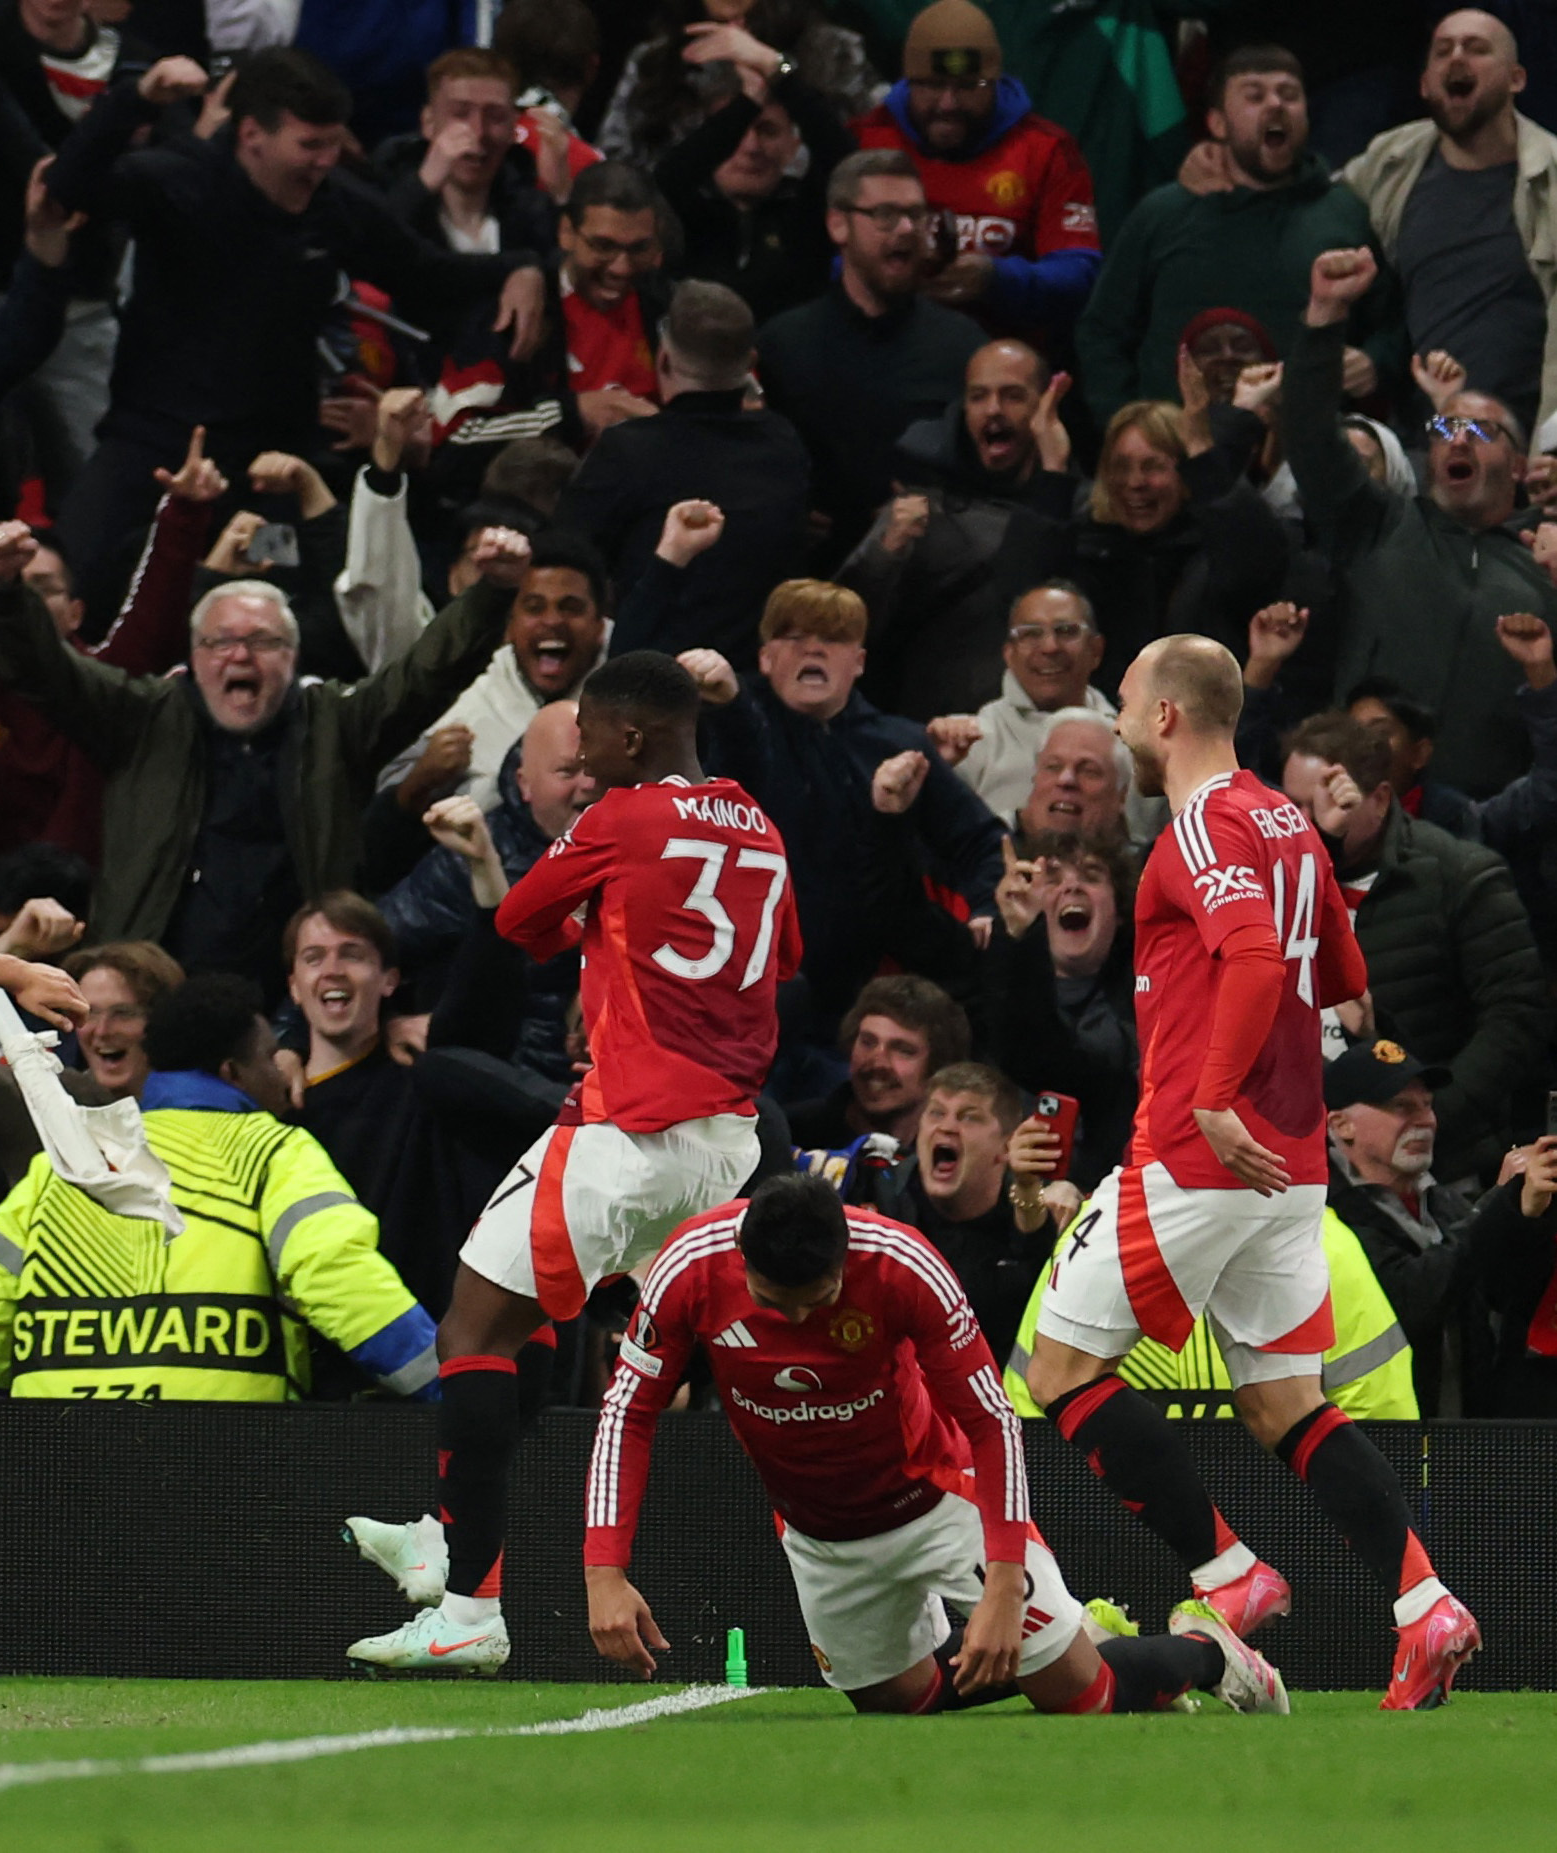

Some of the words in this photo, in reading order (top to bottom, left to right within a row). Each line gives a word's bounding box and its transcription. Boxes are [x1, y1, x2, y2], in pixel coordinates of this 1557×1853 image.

[671, 795, 767, 835] MAINOO
[651, 837, 788, 992] 37
[1272, 852, 1320, 1009] 14
[487, 1163, 536, 1212] 7
[1068, 1208, 1103, 1263] 4
[13, 1305, 271, 1362] STEWARD
[731, 1387, 885, 1425] Snapdragon
